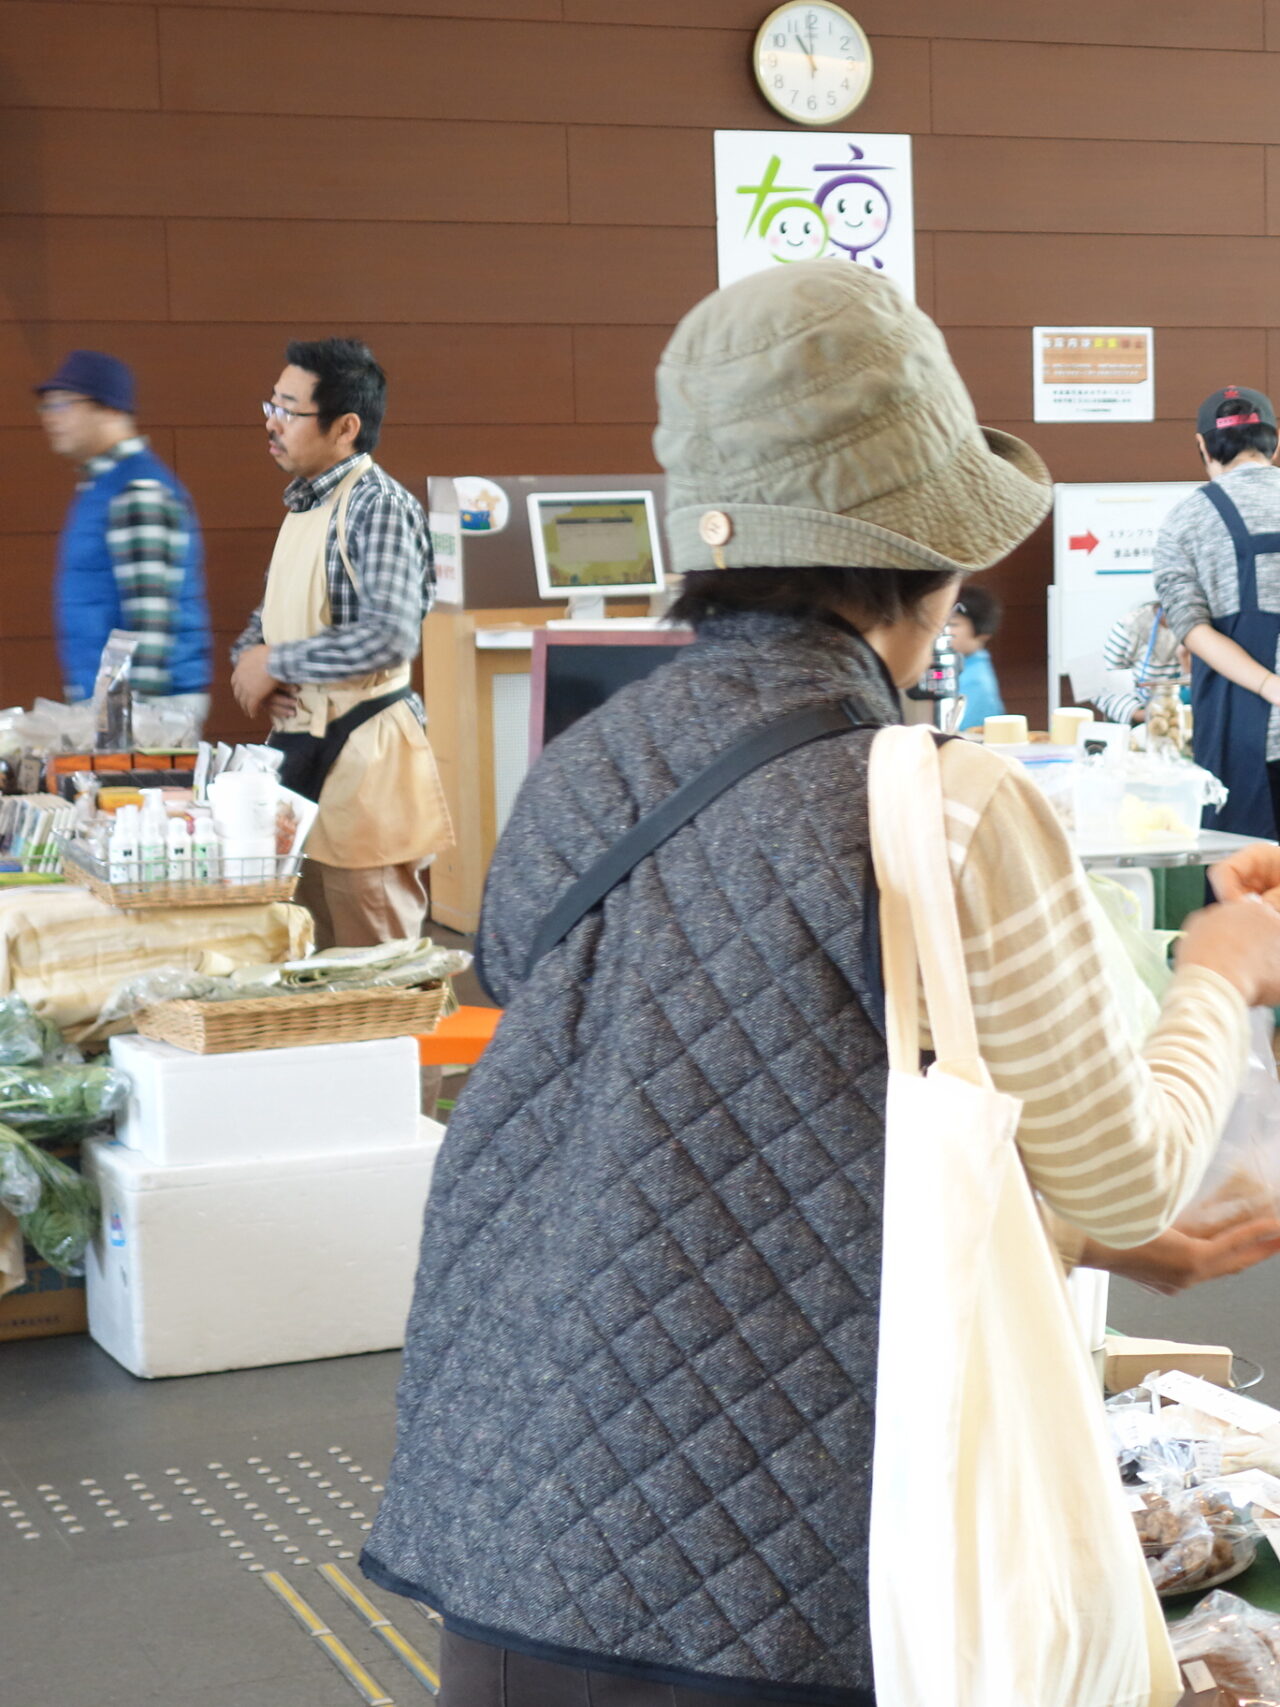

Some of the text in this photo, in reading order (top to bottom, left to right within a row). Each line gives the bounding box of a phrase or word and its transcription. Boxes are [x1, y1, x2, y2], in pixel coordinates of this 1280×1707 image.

[840, 36, 850, 51] 2
[774, 74, 784, 89] 8
[840, 77, 849, 90] 4
[790, 89, 800, 104] 7
[807, 95, 817, 110] 6
[827, 90, 837, 106] 5
